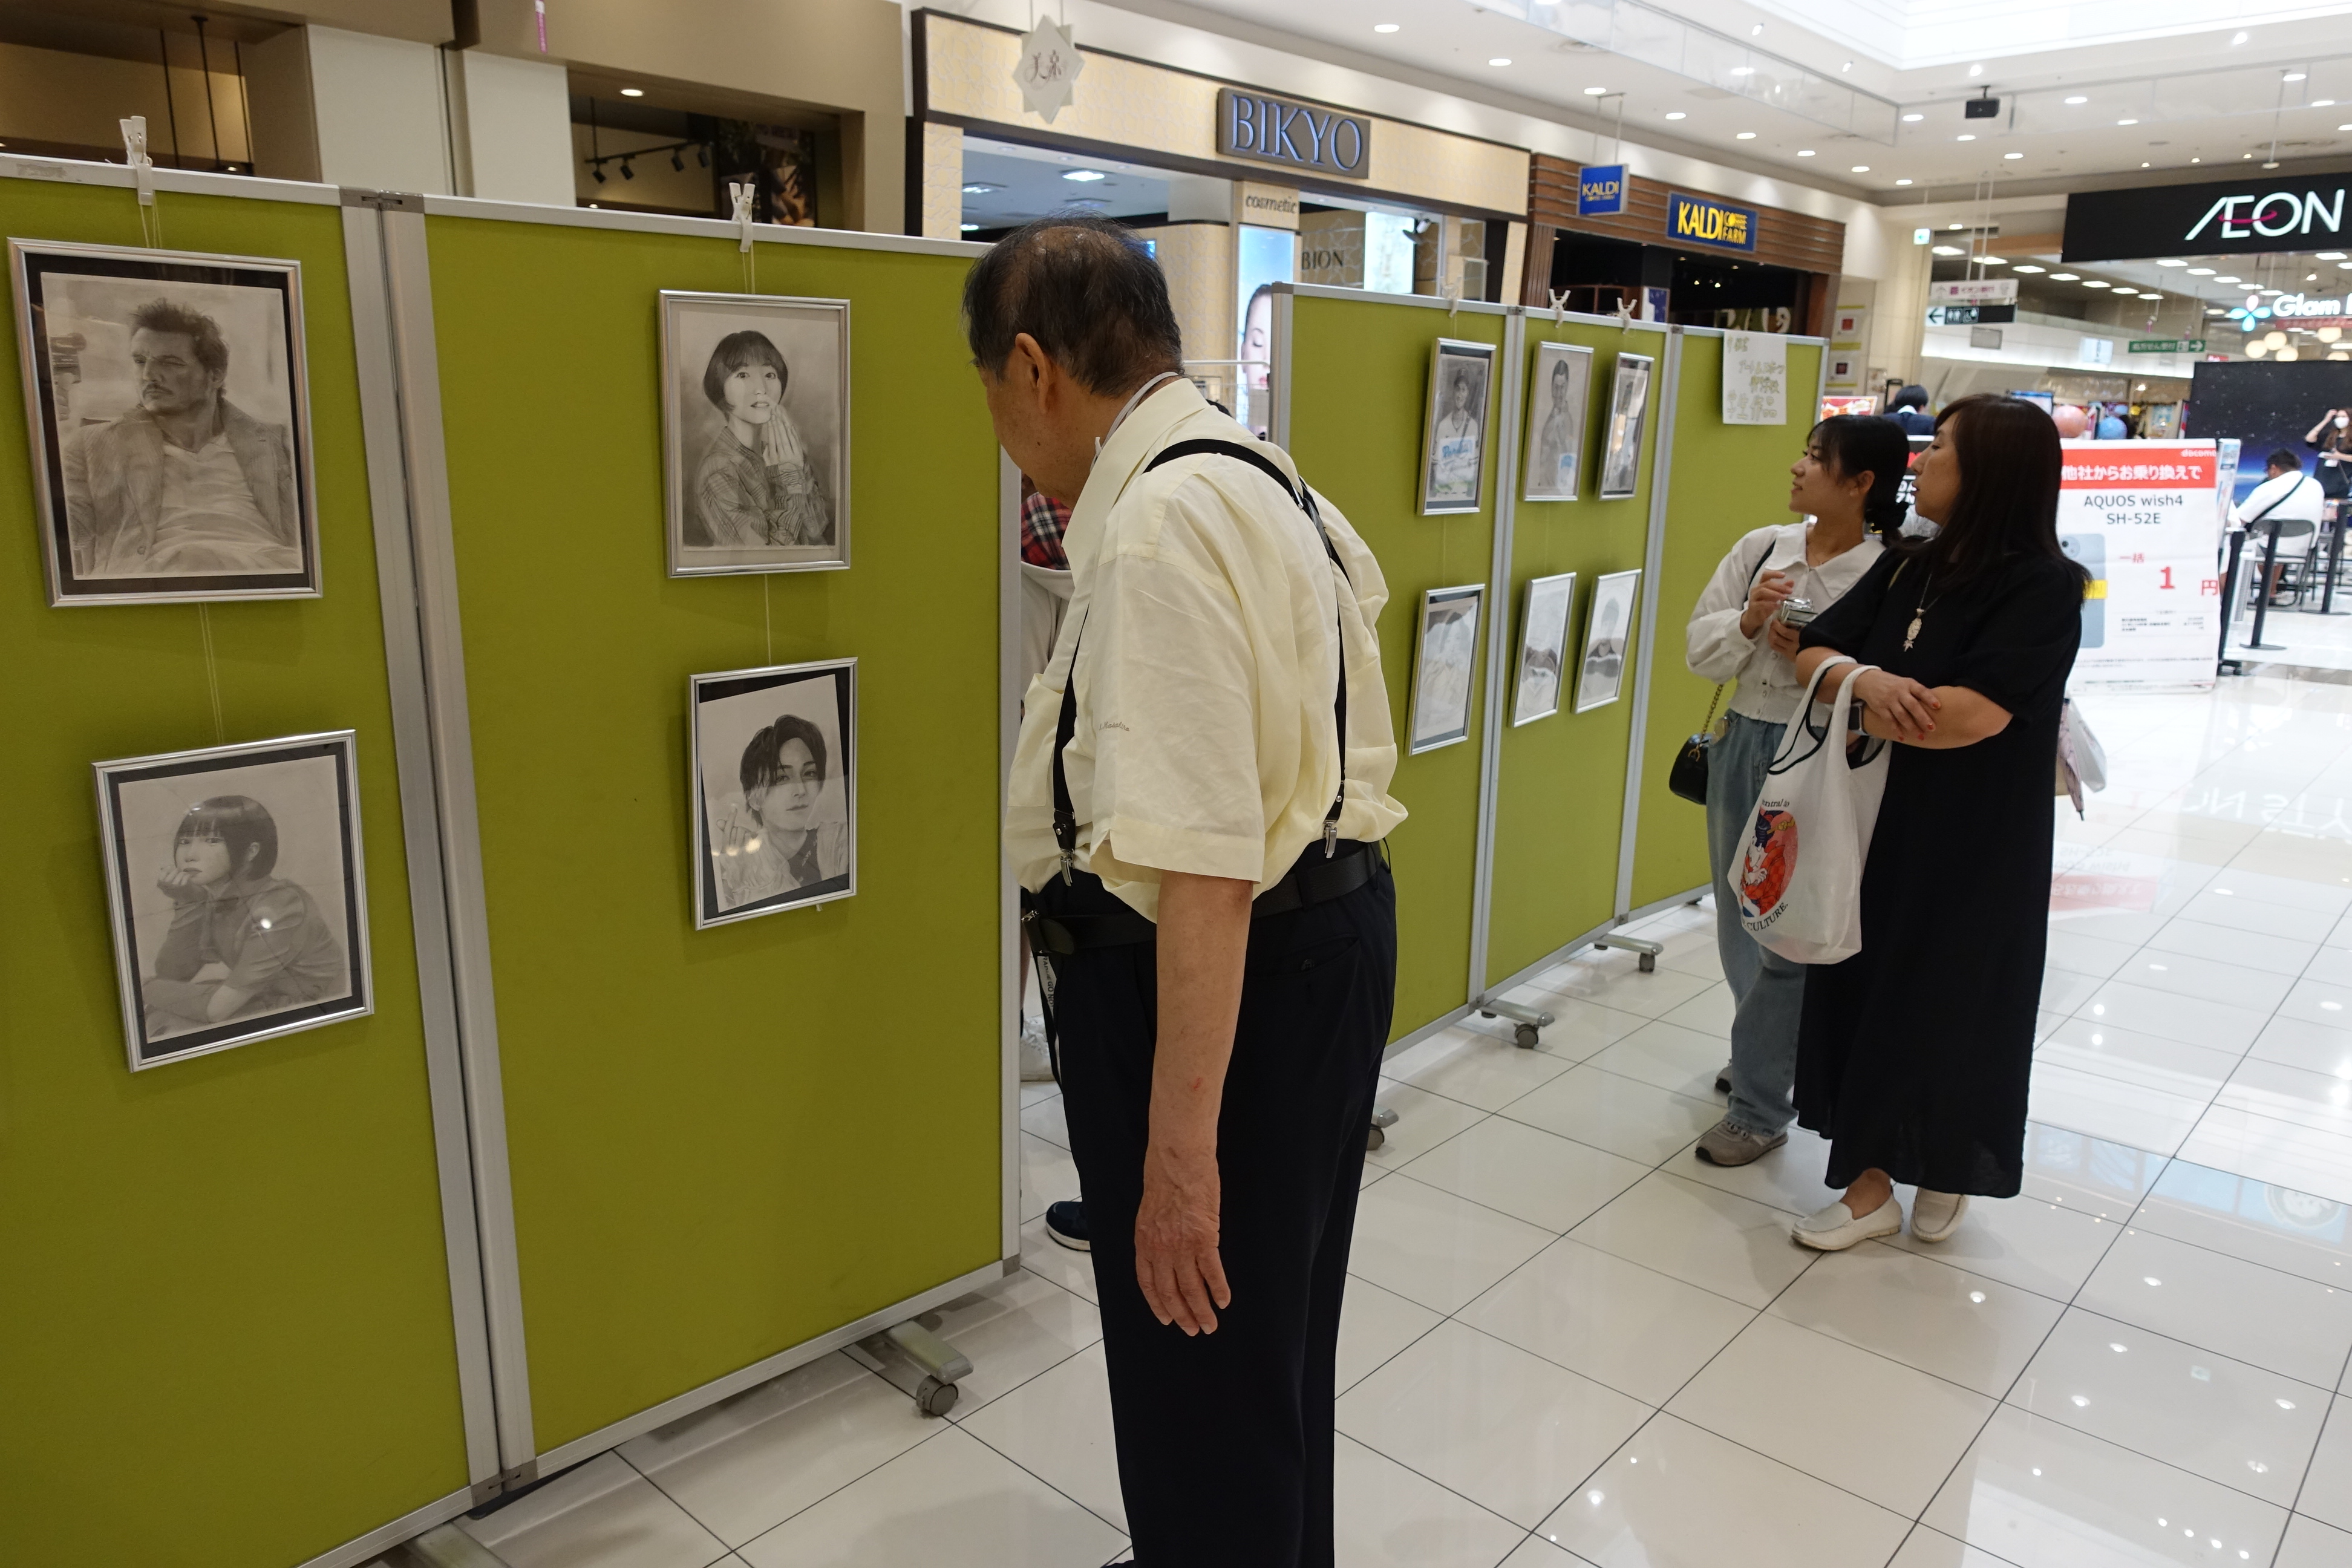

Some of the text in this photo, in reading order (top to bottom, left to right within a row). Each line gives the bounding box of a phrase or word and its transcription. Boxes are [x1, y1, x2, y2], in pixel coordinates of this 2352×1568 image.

[1231, 94, 1361, 171] BIKYO
[1582, 181, 1619, 196] KALDI
[1246, 195, 1297, 214] cosmetic
[1677, 201, 1724, 241] KALDI
[2273, 293, 2341, 317] Glam
[2062, 465, 2203, 481] 他社からお乗り換えで
[2084, 494, 2183, 509] AQUOS wish4
[2106, 513, 2161, 524] SH-52E
[2120, 553, 2145, 563] 一括
[2160, 566, 2218, 596] 1 円
